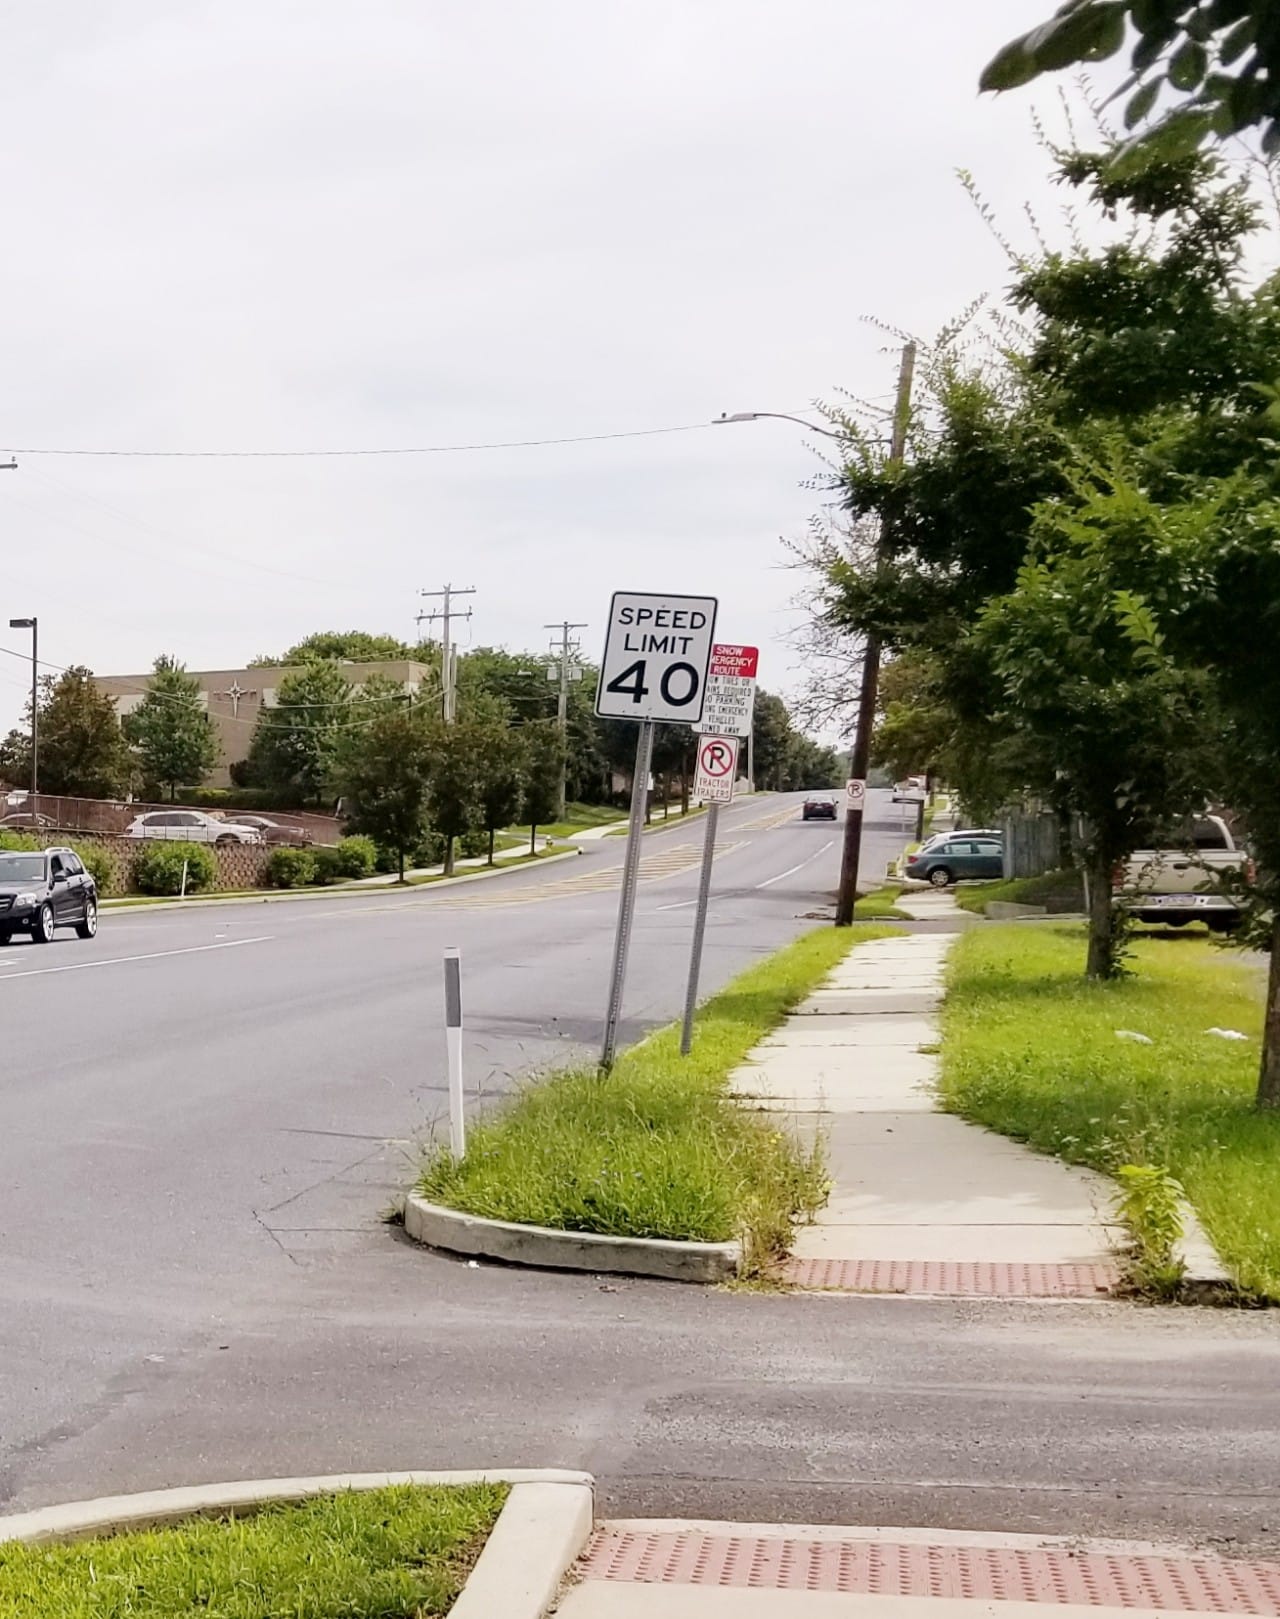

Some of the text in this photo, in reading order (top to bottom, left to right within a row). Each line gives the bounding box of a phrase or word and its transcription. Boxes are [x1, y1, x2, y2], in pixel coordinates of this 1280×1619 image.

[618, 607, 706, 630] SPEED
[623, 633, 694, 655] LIMIT
[716, 646, 744, 657] SNOW
[711, 655, 754, 668] MERGENCY
[713, 665, 741, 676] ROUTE
[606, 659, 699, 707] 40
[715, 695, 745, 706] PARKING
[699, 777, 730, 788] TRACTOR
[696, 786, 729, 799] TRAILERS
